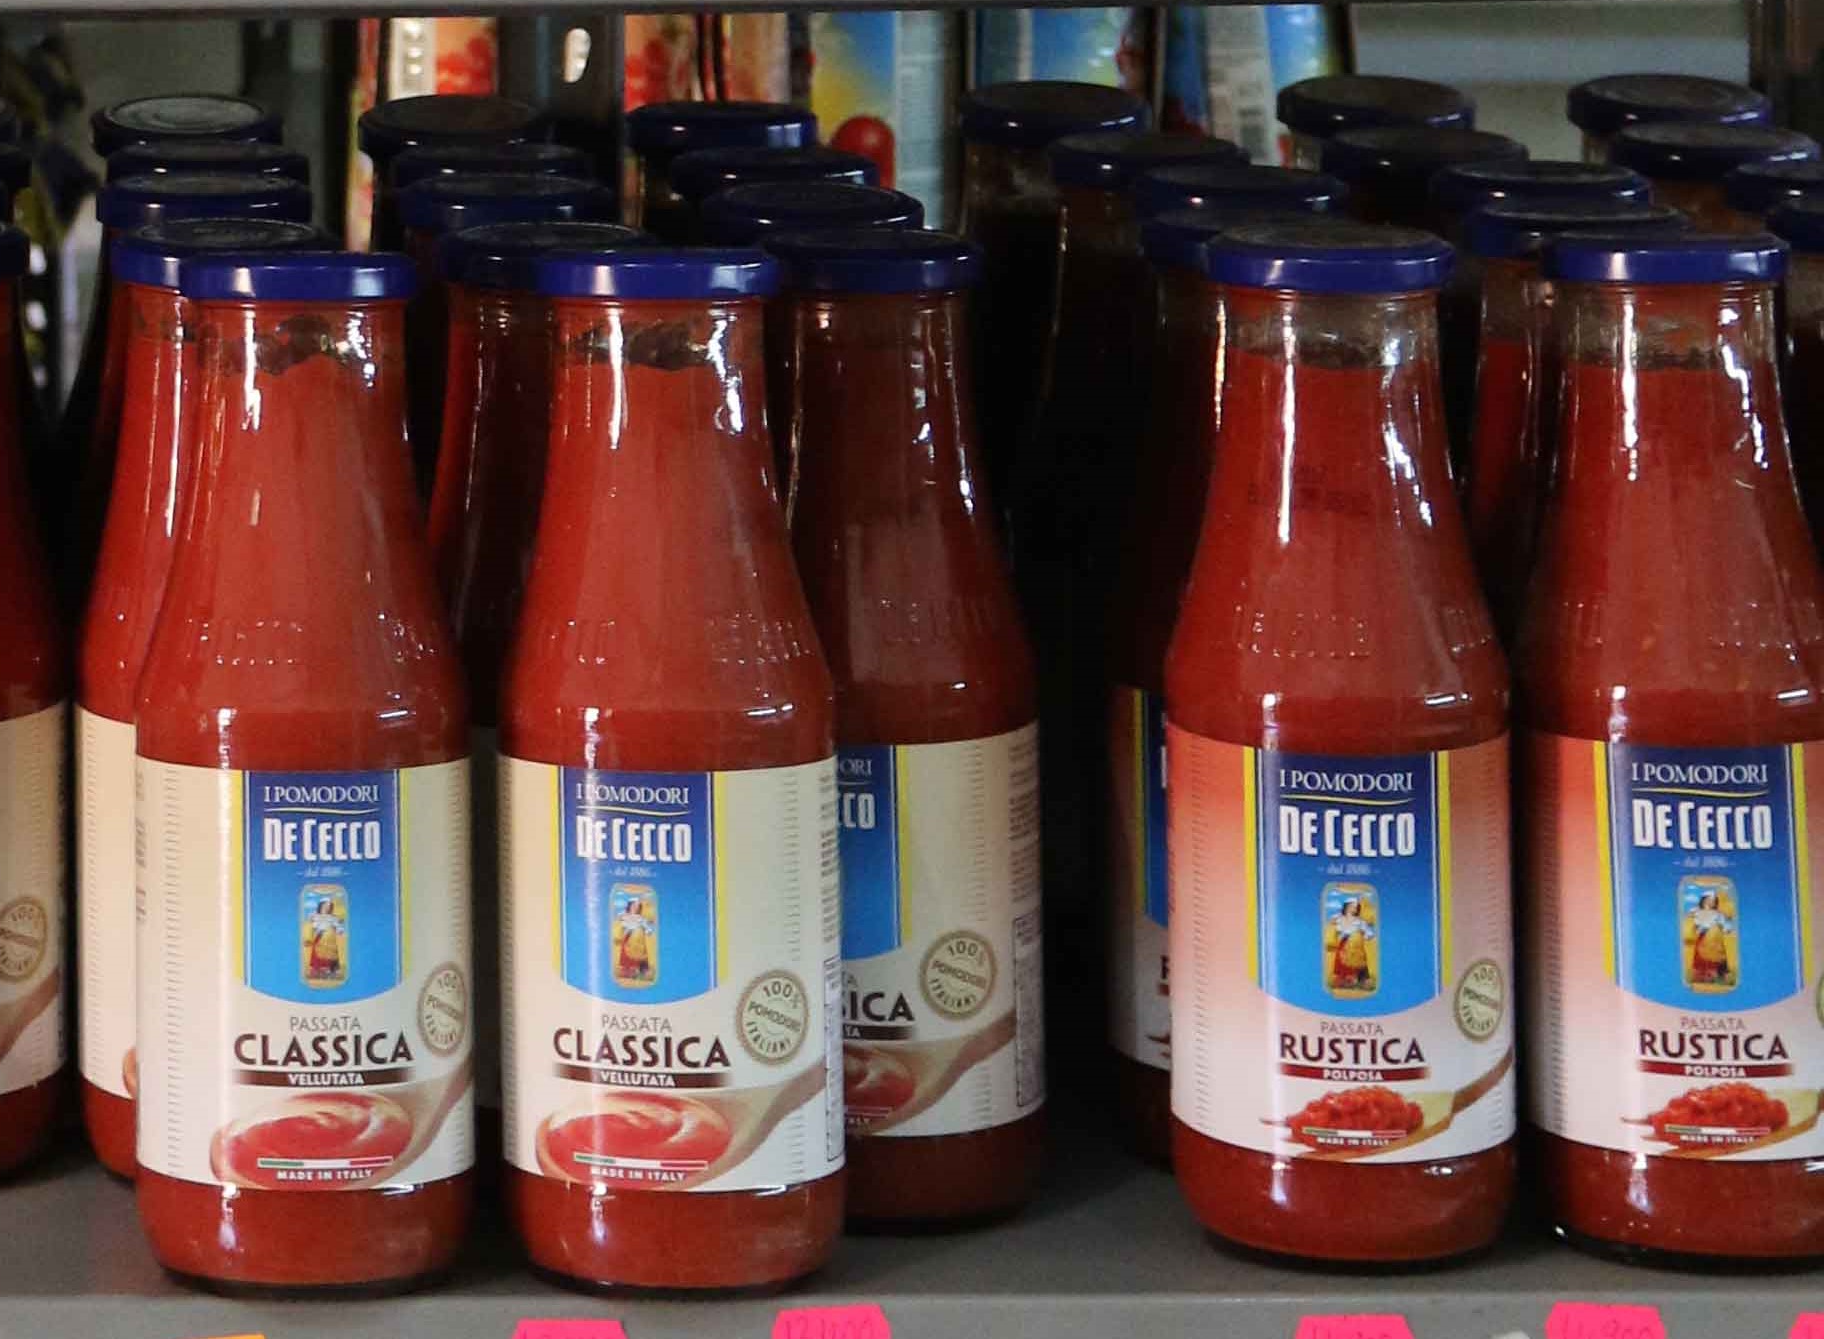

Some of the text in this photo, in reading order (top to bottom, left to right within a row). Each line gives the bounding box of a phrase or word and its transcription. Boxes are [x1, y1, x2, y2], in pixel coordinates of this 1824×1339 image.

[1289, 769, 1414, 793] POMODORI
[1641, 761, 1768, 786] POMODORI
[272, 783, 379, 805] POMODORI
[1279, 805, 1416, 857] DE CECCO
[1632, 797, 1773, 850] DE CECCO
[264, 818, 380, 861] DE CECCO
[577, 816, 691, 862] DE CECCO
[762, 979, 802, 1009] 100%
[289, 1015, 361, 1033] PASSATA
[601, 1012, 672, 1033] PASSATA
[1320, 1021, 1384, 1037] PASSATA
[1680, 1015, 1746, 1032] PASSATA
[233, 1032, 413, 1067] CLASSICA
[554, 1026, 730, 1068] CLASSICA
[1279, 1035, 1425, 1064] RUSTICA
[1638, 1028, 1789, 1060] RUSTICA
[288, 1071, 364, 1087] VELLUTATA
[600, 1070, 675, 1088] VELLUTATA
[1323, 1068, 1383, 1082] POLPOSA
[1684, 1065, 1746, 1079] POLPOSA
